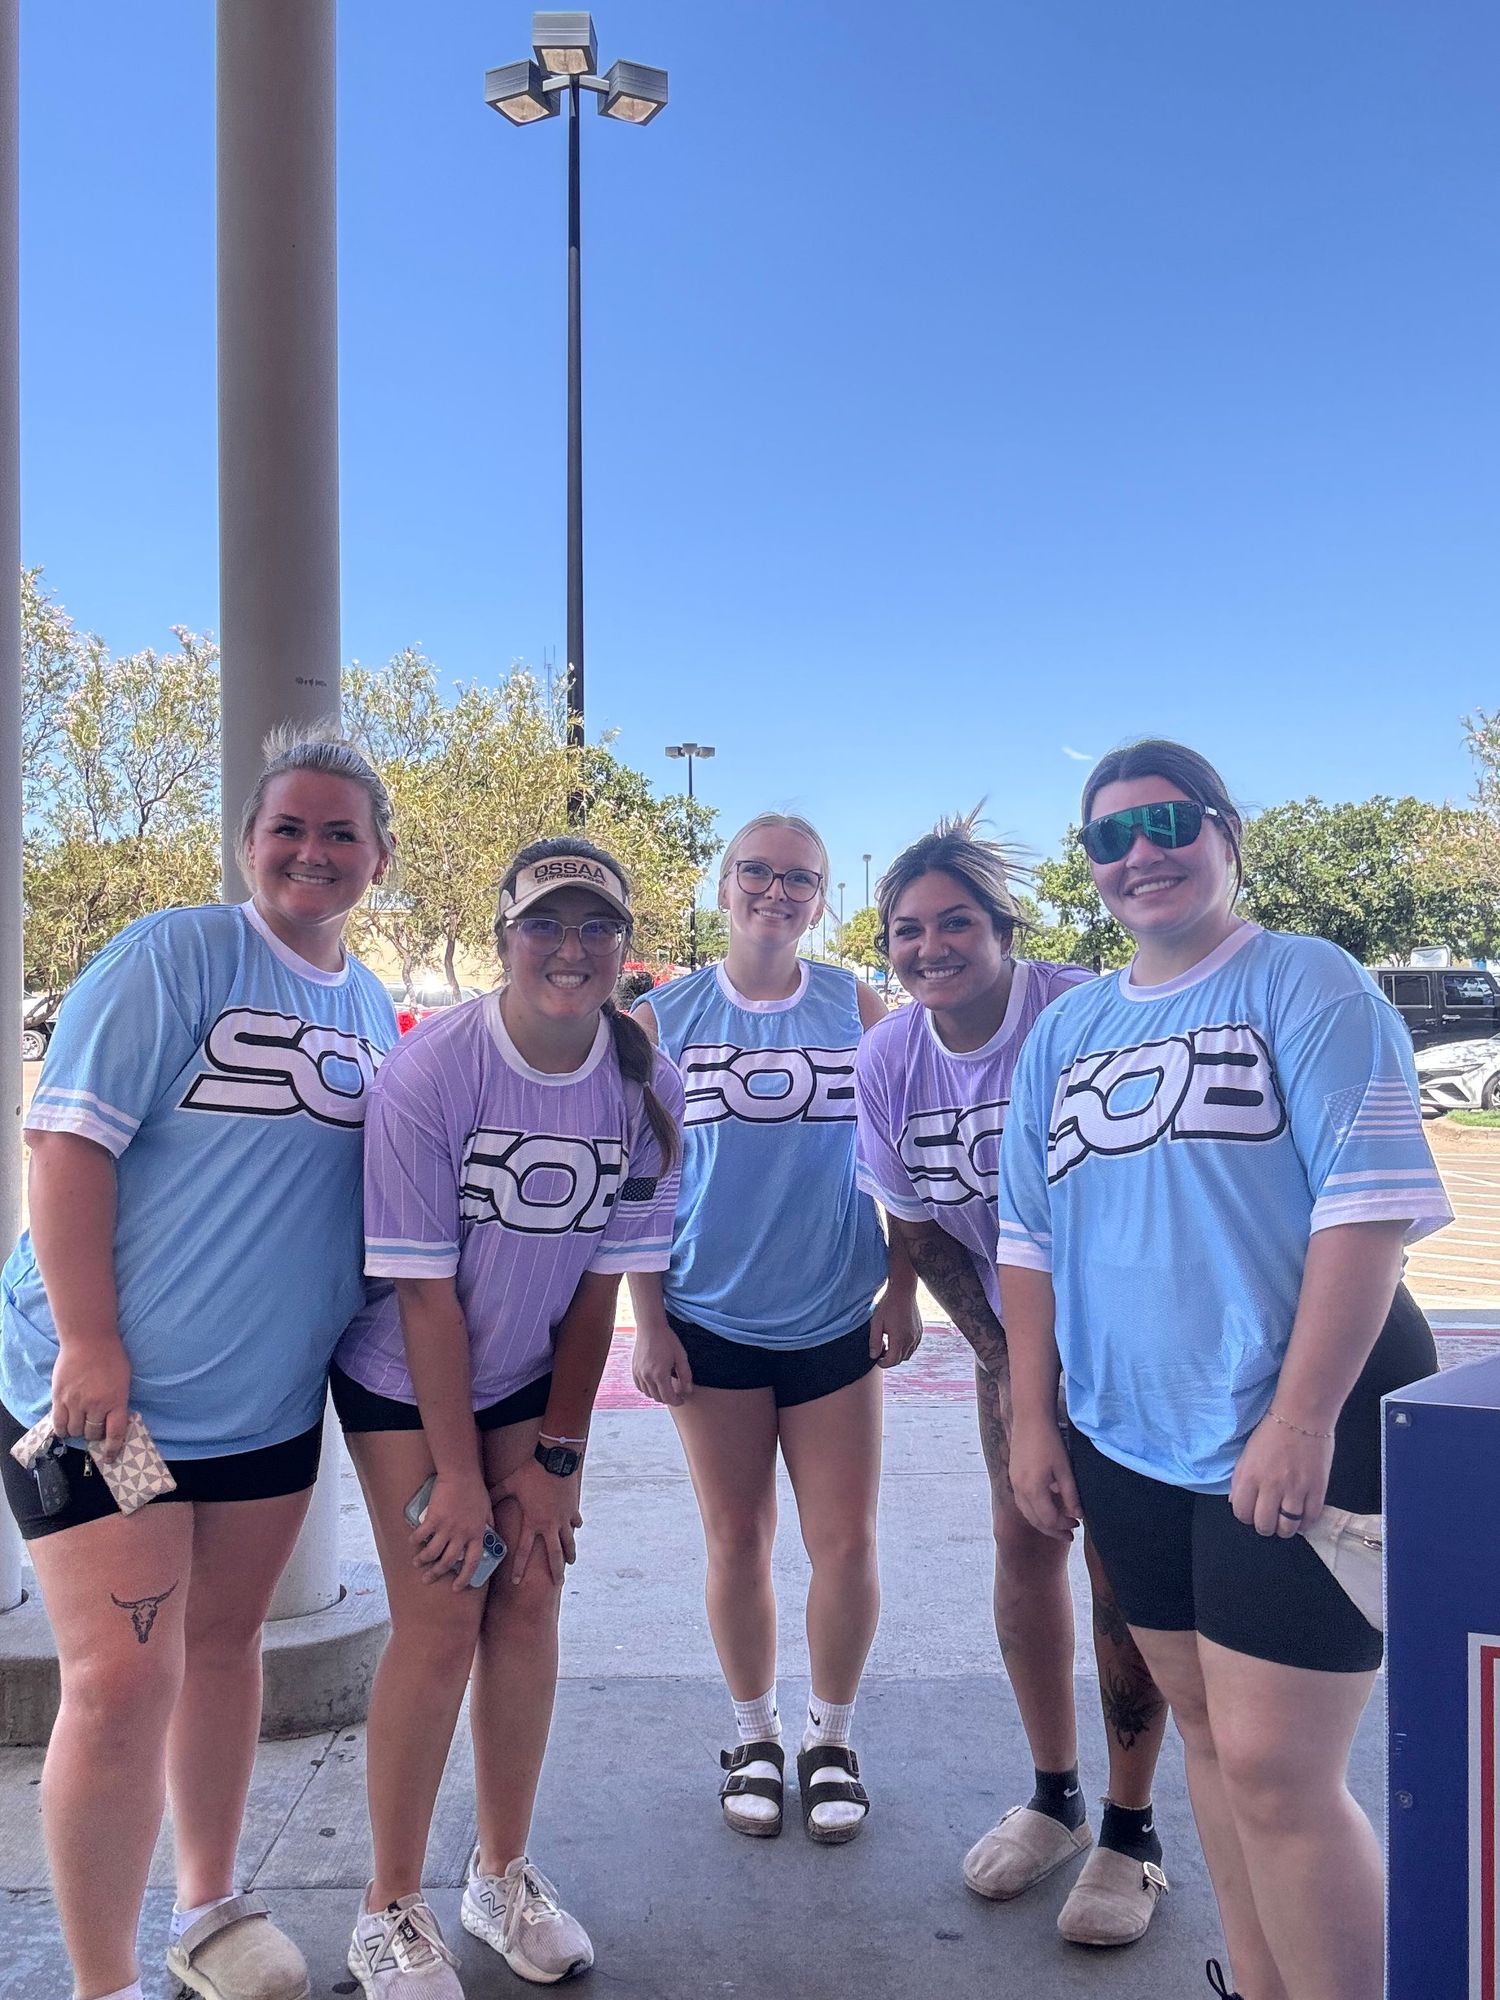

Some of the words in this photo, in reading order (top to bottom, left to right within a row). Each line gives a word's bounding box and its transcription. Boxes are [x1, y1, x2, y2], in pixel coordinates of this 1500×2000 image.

[534, 862, 607, 883] OSSAA
[175, 1006, 388, 1130] SO
[896, 1099, 1010, 1206] SO
